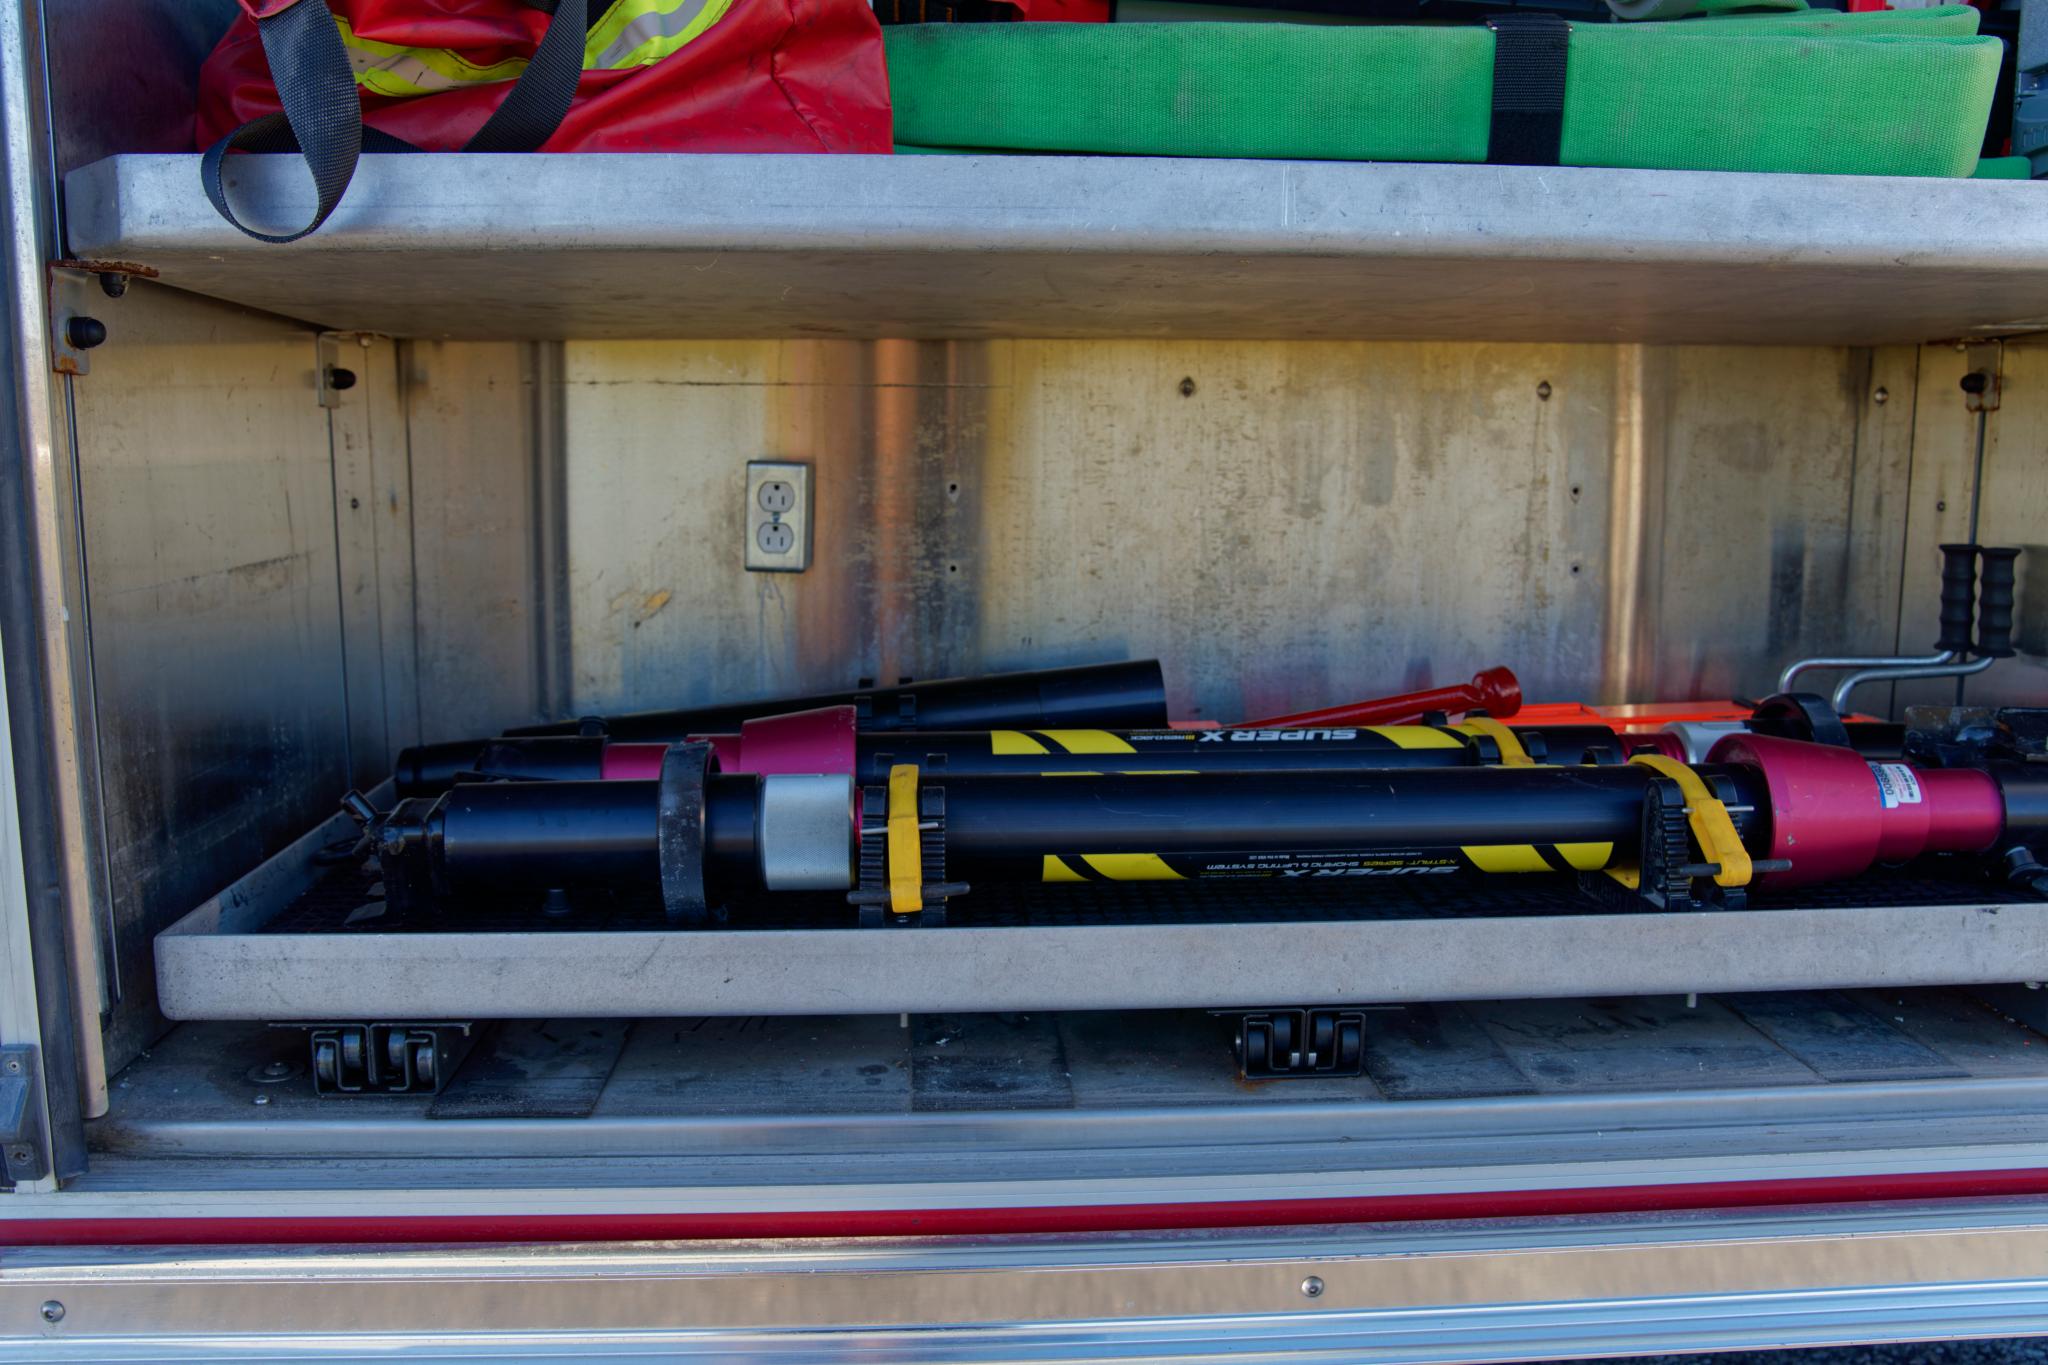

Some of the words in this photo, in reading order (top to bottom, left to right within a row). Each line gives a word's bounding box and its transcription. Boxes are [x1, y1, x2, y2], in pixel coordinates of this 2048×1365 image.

[1199, 730, 1225, 742] X
[1230, 729, 1357, 742] SUPER
[1281, 869, 1311, 877] X
[1310, 866, 1460, 877] SUPER
